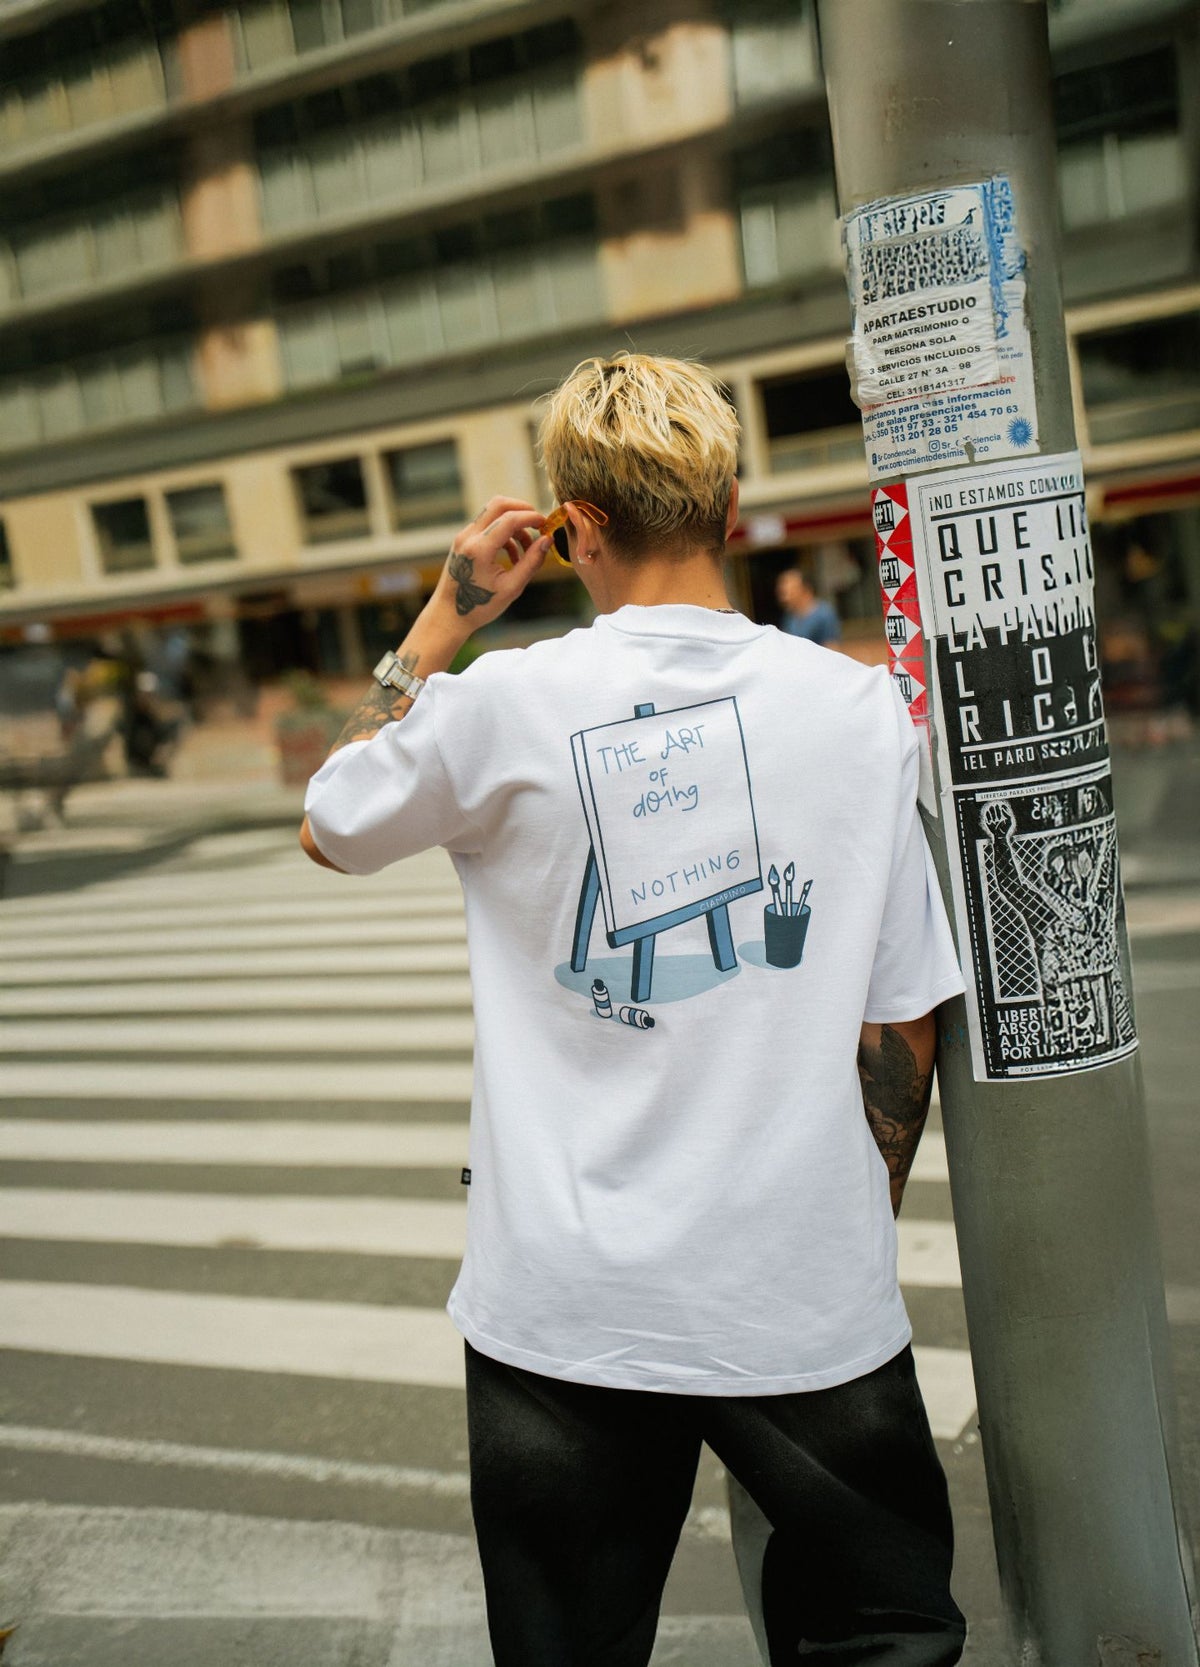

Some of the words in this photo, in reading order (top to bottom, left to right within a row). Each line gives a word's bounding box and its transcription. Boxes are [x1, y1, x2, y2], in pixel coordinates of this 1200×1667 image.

[864, 296, 977, 334] APARTAESTUDIO
[872, 334, 893, 345] PARA
[895, 319, 959, 339] MATRIMONIO
[884, 340, 927, 356] PERSONA
[929, 335, 957, 346] SOLA
[877, 357, 922, 374] SERVICIOS
[924, 345, 981, 361] INCLUIDOS
[908, 371, 919, 380] 27
[936, 366, 949, 374] 3A
[959, 361, 971, 370] 98
[907, 377, 965, 395] 3118141317
[898, 403, 920, 415] para
[947, 387, 1011, 404] información
[909, 402, 977, 422] presenciales
[907, 421, 918, 430] 97
[922, 418, 934, 428] 33
[943, 414, 963, 423] 321
[967, 409, 987, 419] 454
[990, 407, 1003, 416] 70
[1006, 405, 1018, 414] 63
[908, 430, 925, 440] 201
[928, 426, 942, 436] 28
[944, 423, 958, 433] 05
[960, 481, 1024, 505] ESTAMOS
[937, 511, 1031, 562] QUE
[947, 612, 988, 653] LA
[597, 741, 647, 774] THE
[660, 724, 705, 760] ART
[995, 746, 1035, 767] PARO
[632, 784, 699, 818] doing
[630, 849, 741, 906] NOTHING
[700, 886, 746, 911] CIAMPINO
[1000, 1034, 1012, 1048] A
[1015, 1033, 1041, 1047] LXS
[1002, 1046, 1033, 1060] POR
